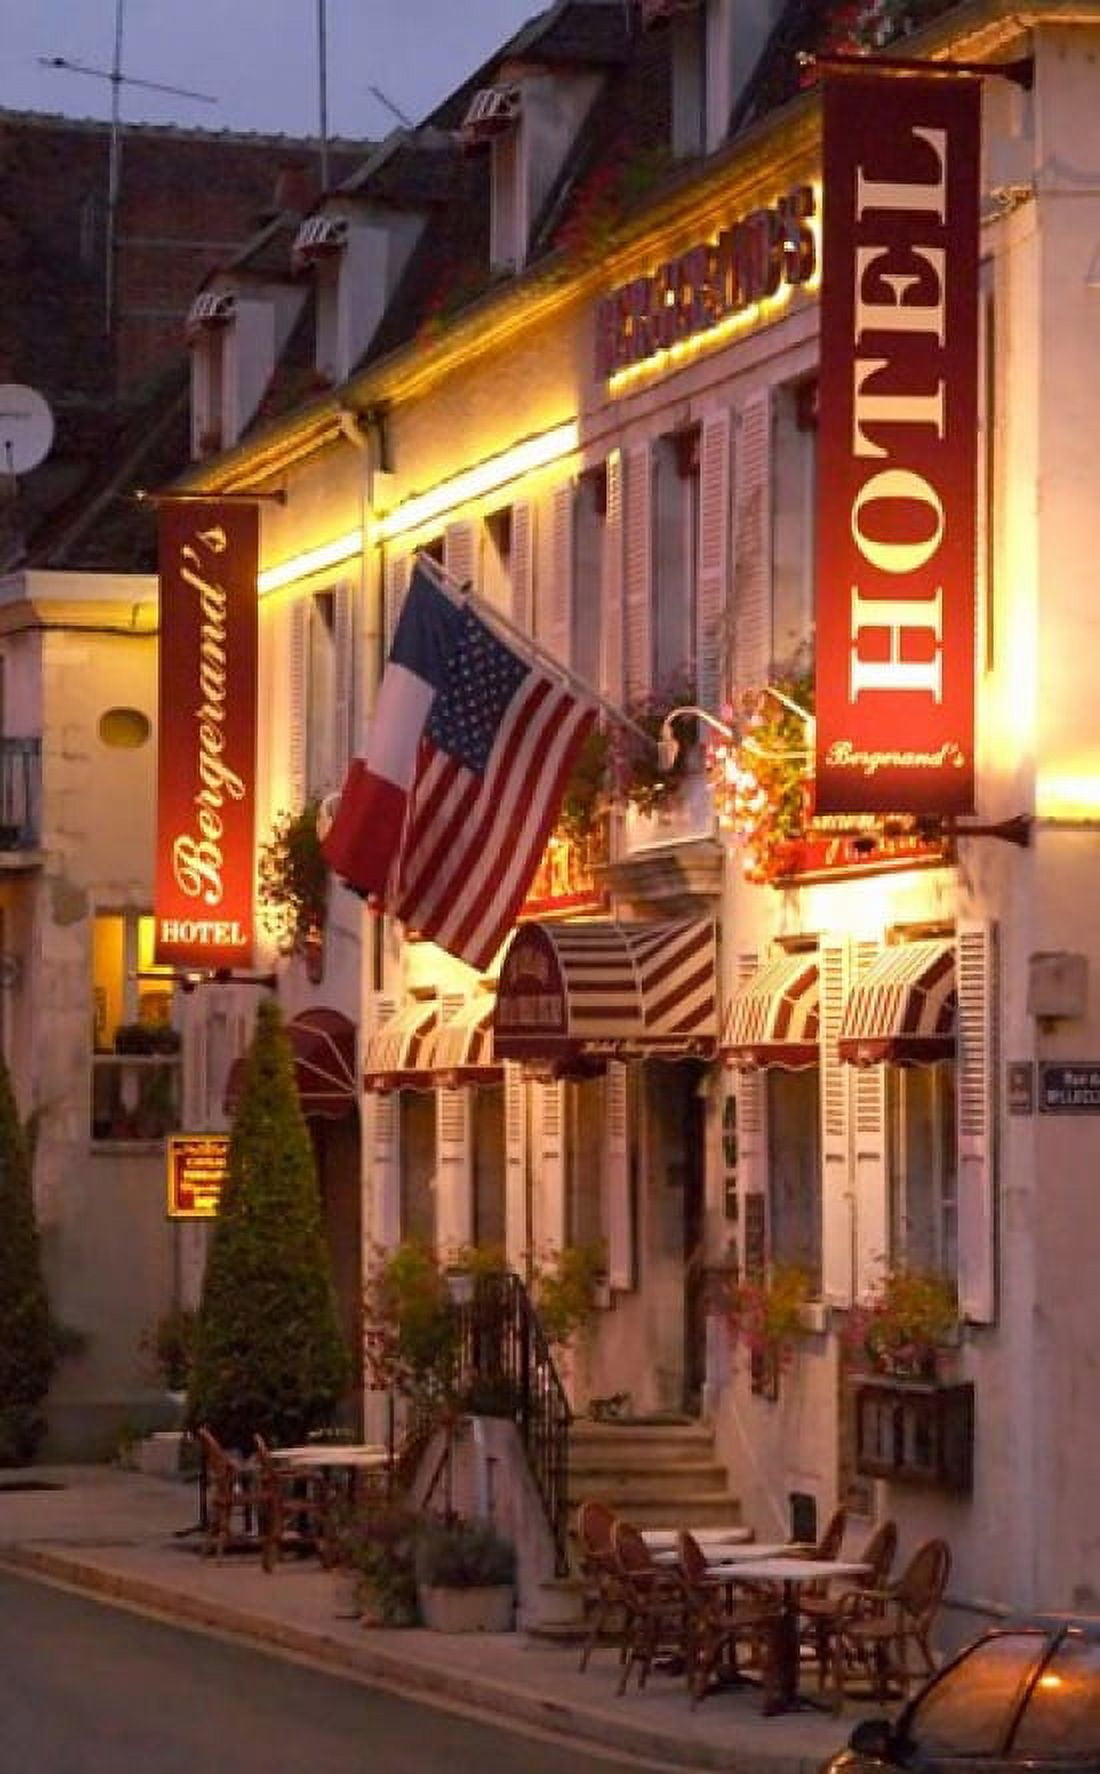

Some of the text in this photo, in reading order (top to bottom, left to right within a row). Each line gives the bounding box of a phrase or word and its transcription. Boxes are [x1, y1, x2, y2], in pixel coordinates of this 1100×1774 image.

[851, 127, 948, 704] HOTEL
[173, 525, 246, 906] Bergerand's
[161, 920, 247, 945] HOTEL
